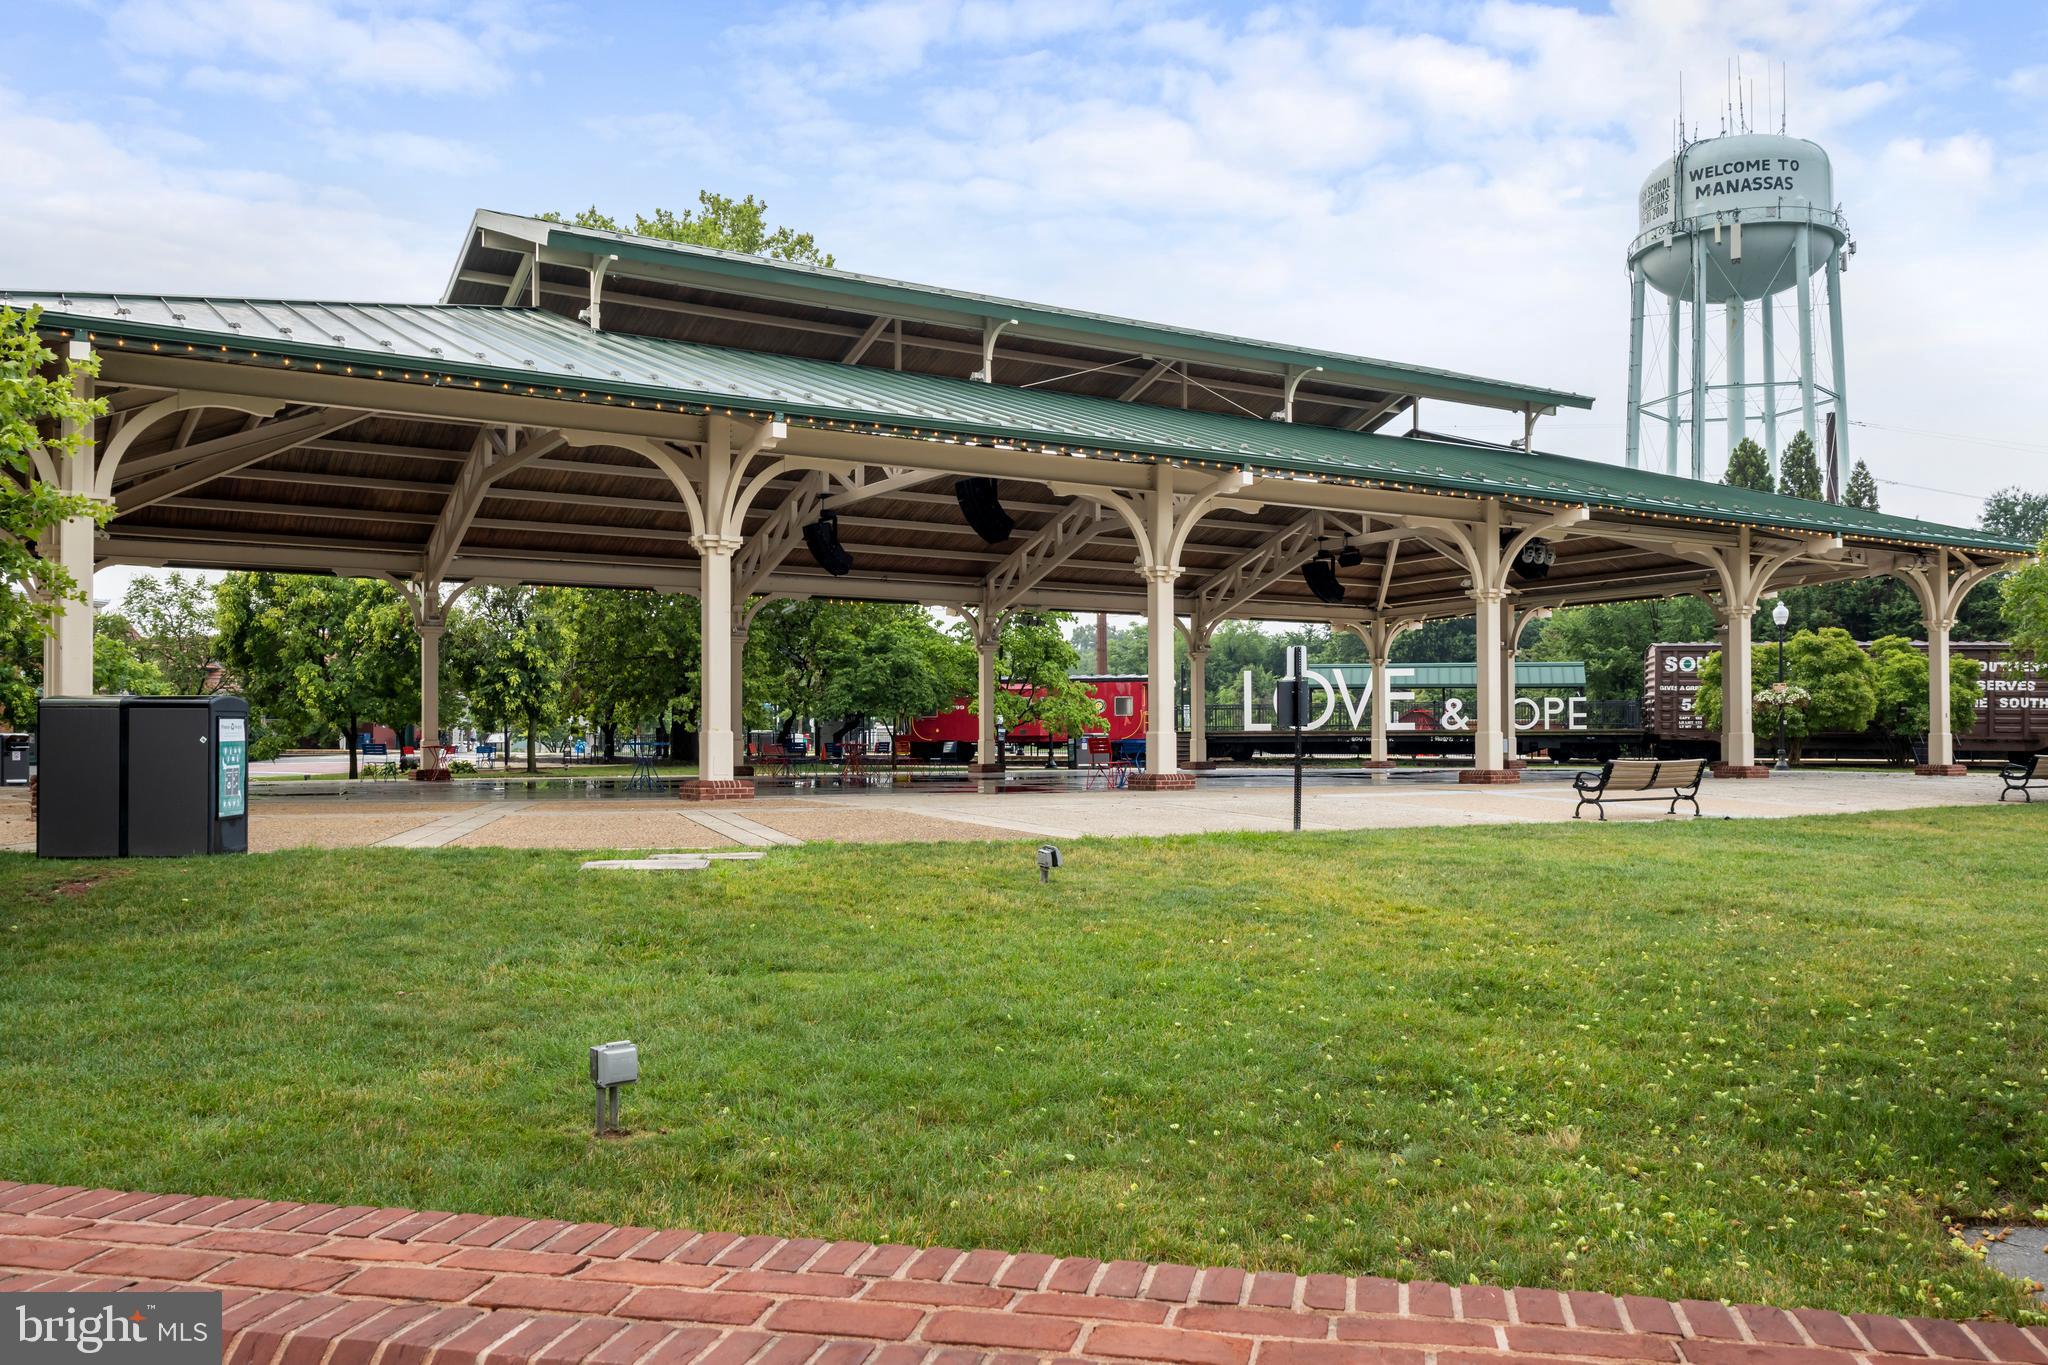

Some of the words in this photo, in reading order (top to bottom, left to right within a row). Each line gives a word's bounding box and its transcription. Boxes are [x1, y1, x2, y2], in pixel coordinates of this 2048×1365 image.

[1689, 159, 1770, 182] WELCOME
[1778, 159, 1799, 172] TO
[1648, 177, 1670, 198] SCHOOL
[1695, 176, 1794, 199] MANASSAS
[1976, 680, 2036, 691] SERVES
[1243, 668, 1416, 731] LOVE
[2000, 697, 2048, 708] SOUTH
[1441, 698, 1470, 731] &
[1513, 697, 1588, 730] OPE
